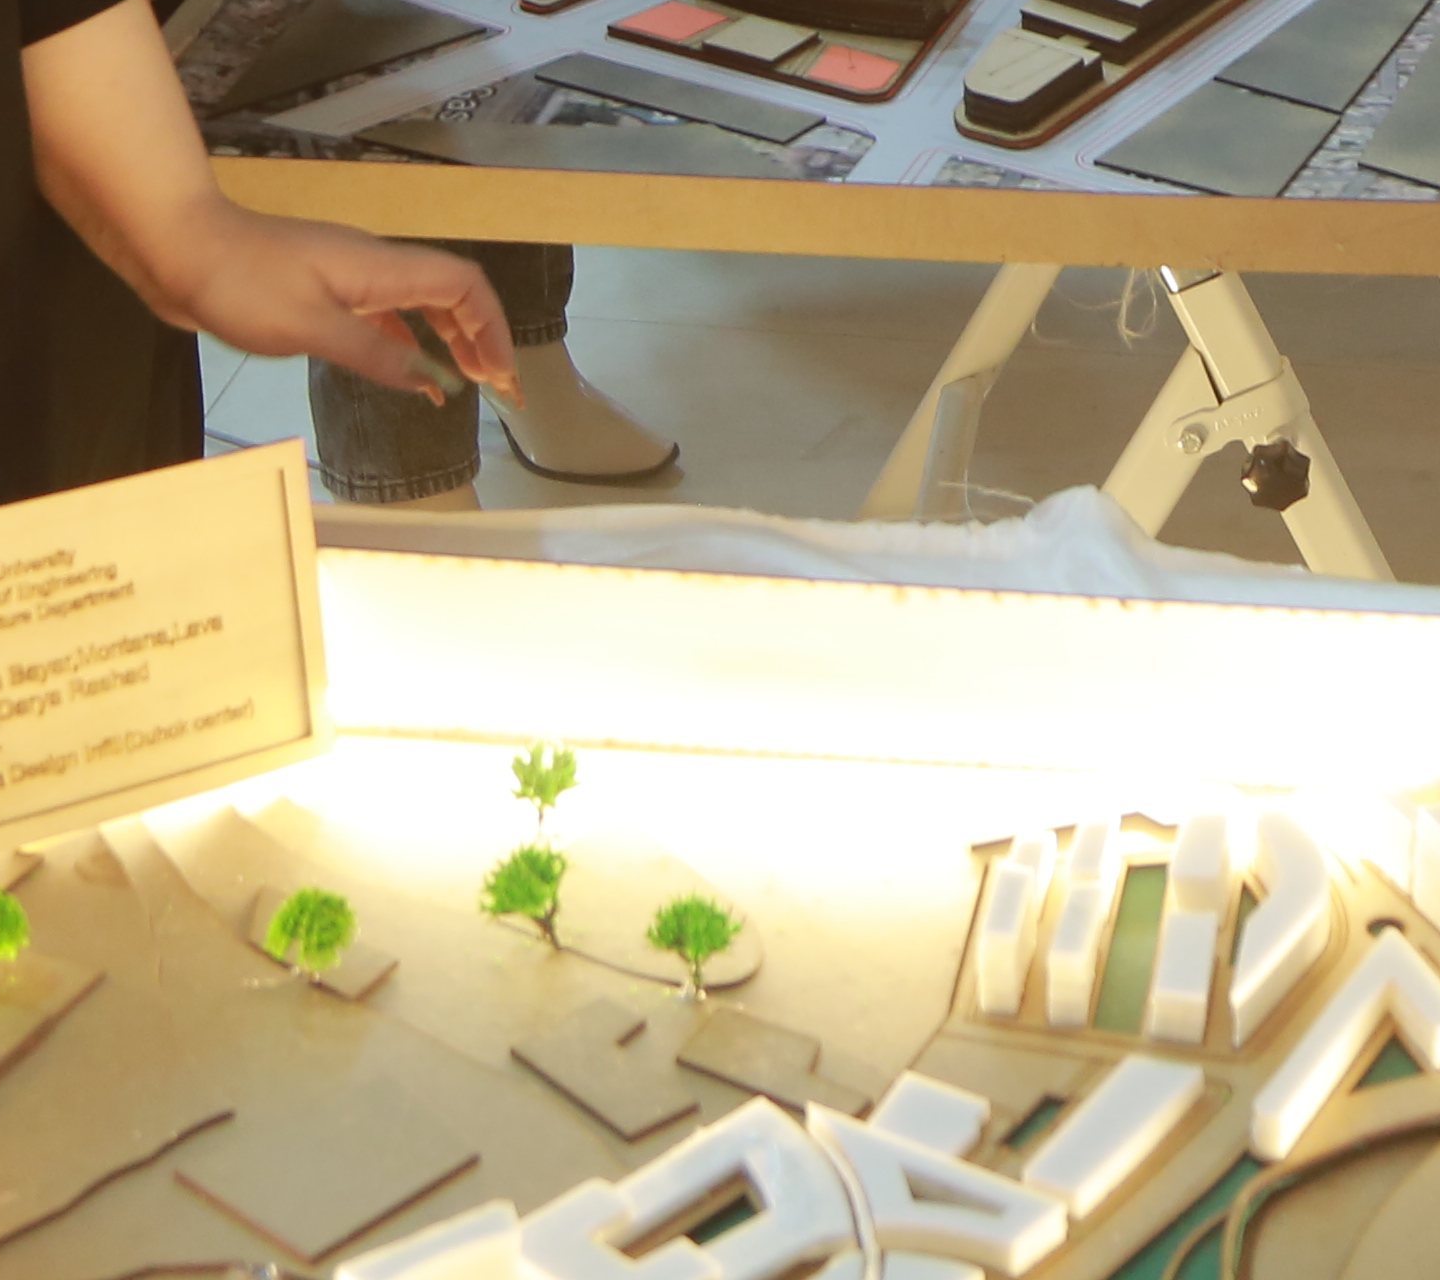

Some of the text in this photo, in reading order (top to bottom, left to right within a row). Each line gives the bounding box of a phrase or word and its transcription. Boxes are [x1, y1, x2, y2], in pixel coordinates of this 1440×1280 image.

[17, 563, 118, 602] Engineering
[35, 582, 135, 621] Department
[11, 748, 78, 782] Design
